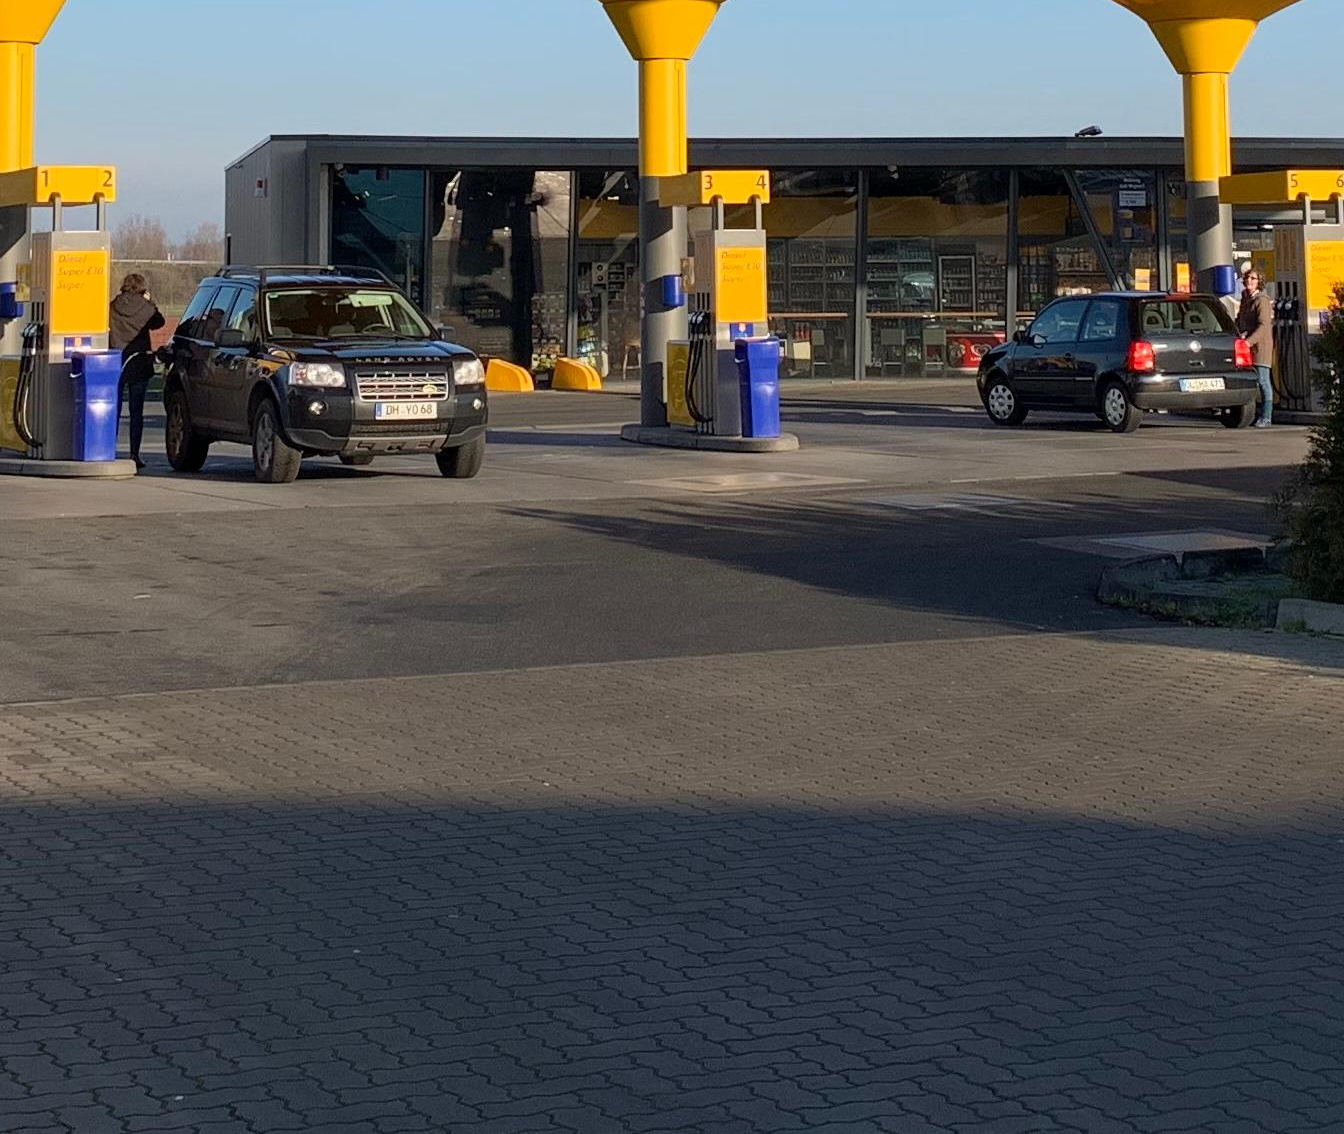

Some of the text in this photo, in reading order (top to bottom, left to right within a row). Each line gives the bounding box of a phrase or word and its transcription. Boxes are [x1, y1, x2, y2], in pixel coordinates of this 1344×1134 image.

[39, 170, 113, 187] 1 2
[704, 174, 767, 190] 3 4
[1290, 173, 1344, 187] 5 6
